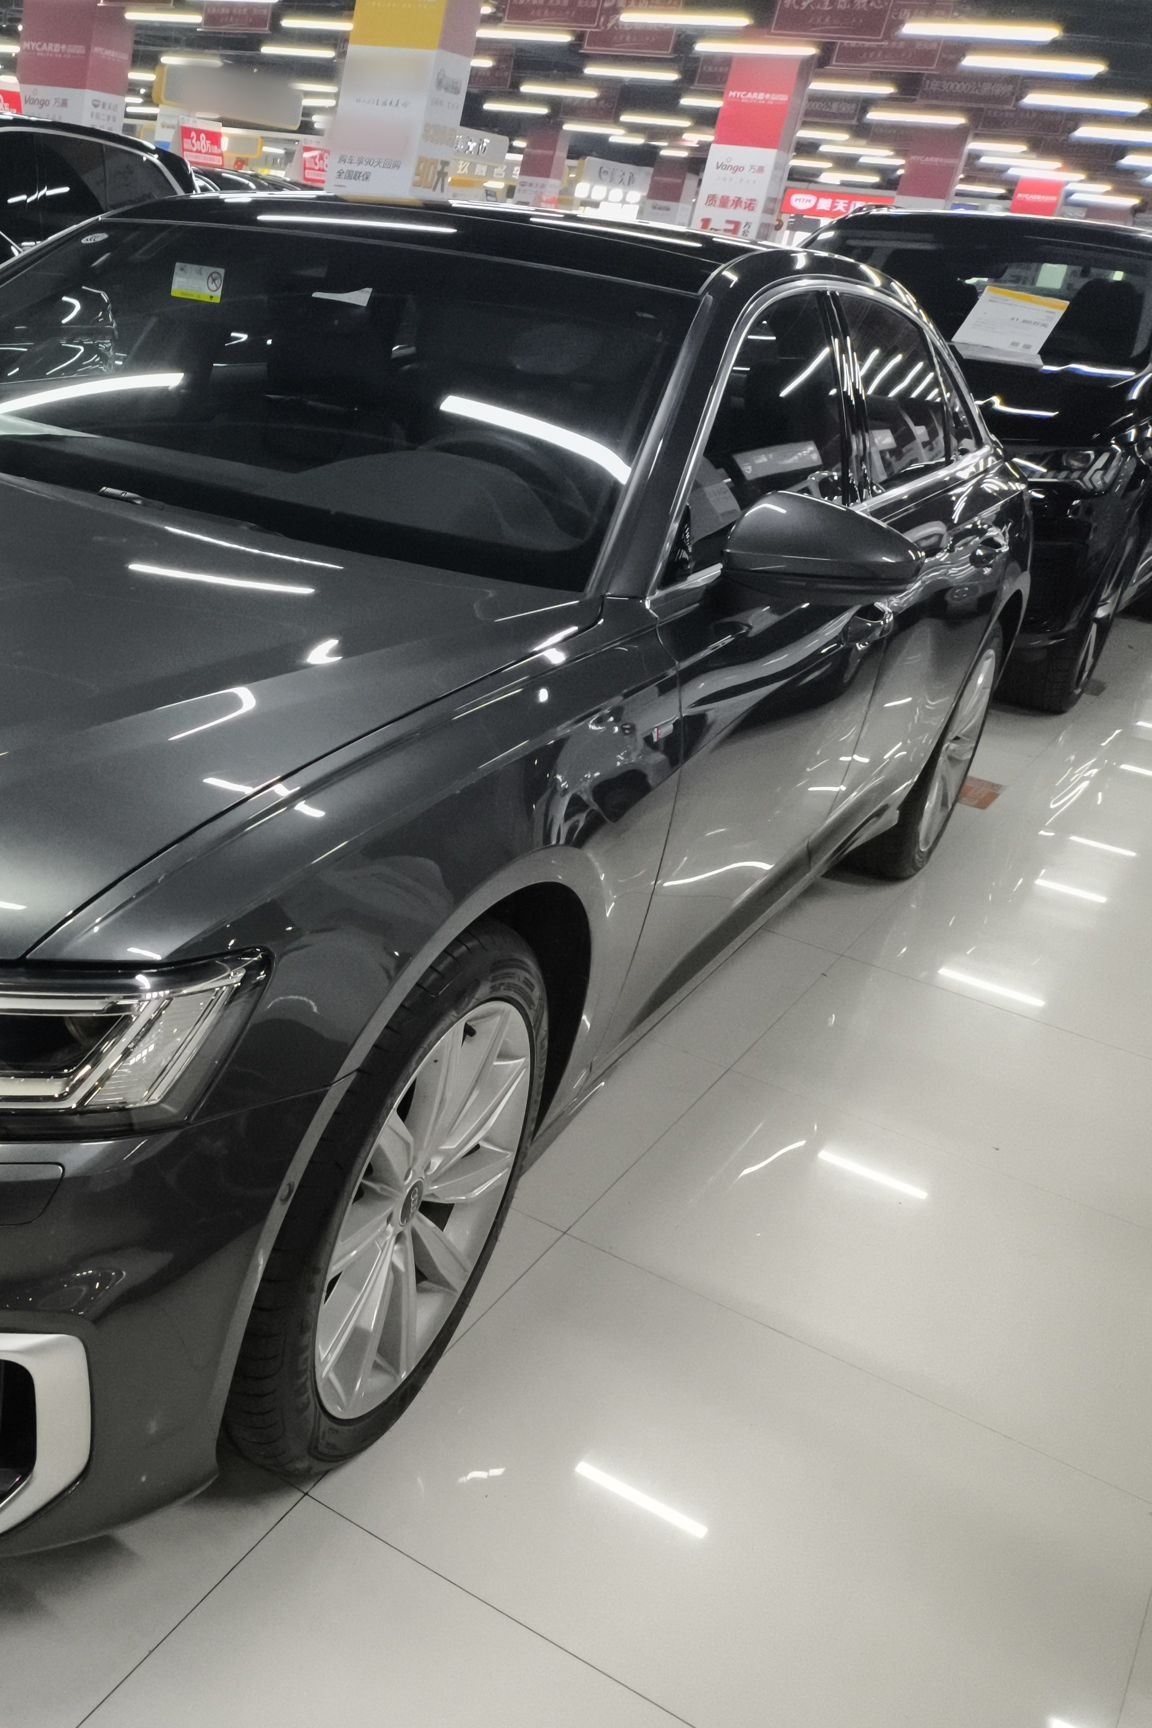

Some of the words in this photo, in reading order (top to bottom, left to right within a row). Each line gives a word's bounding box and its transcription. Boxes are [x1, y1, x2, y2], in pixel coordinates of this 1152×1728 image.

[24, 95, 50, 109] Vango
[336, 168, 371, 182] 全国联保
[413, 155, 450, 193] 90天
[715, 161, 745, 175] Vango
[704, 193, 757, 212] 质量承诺
